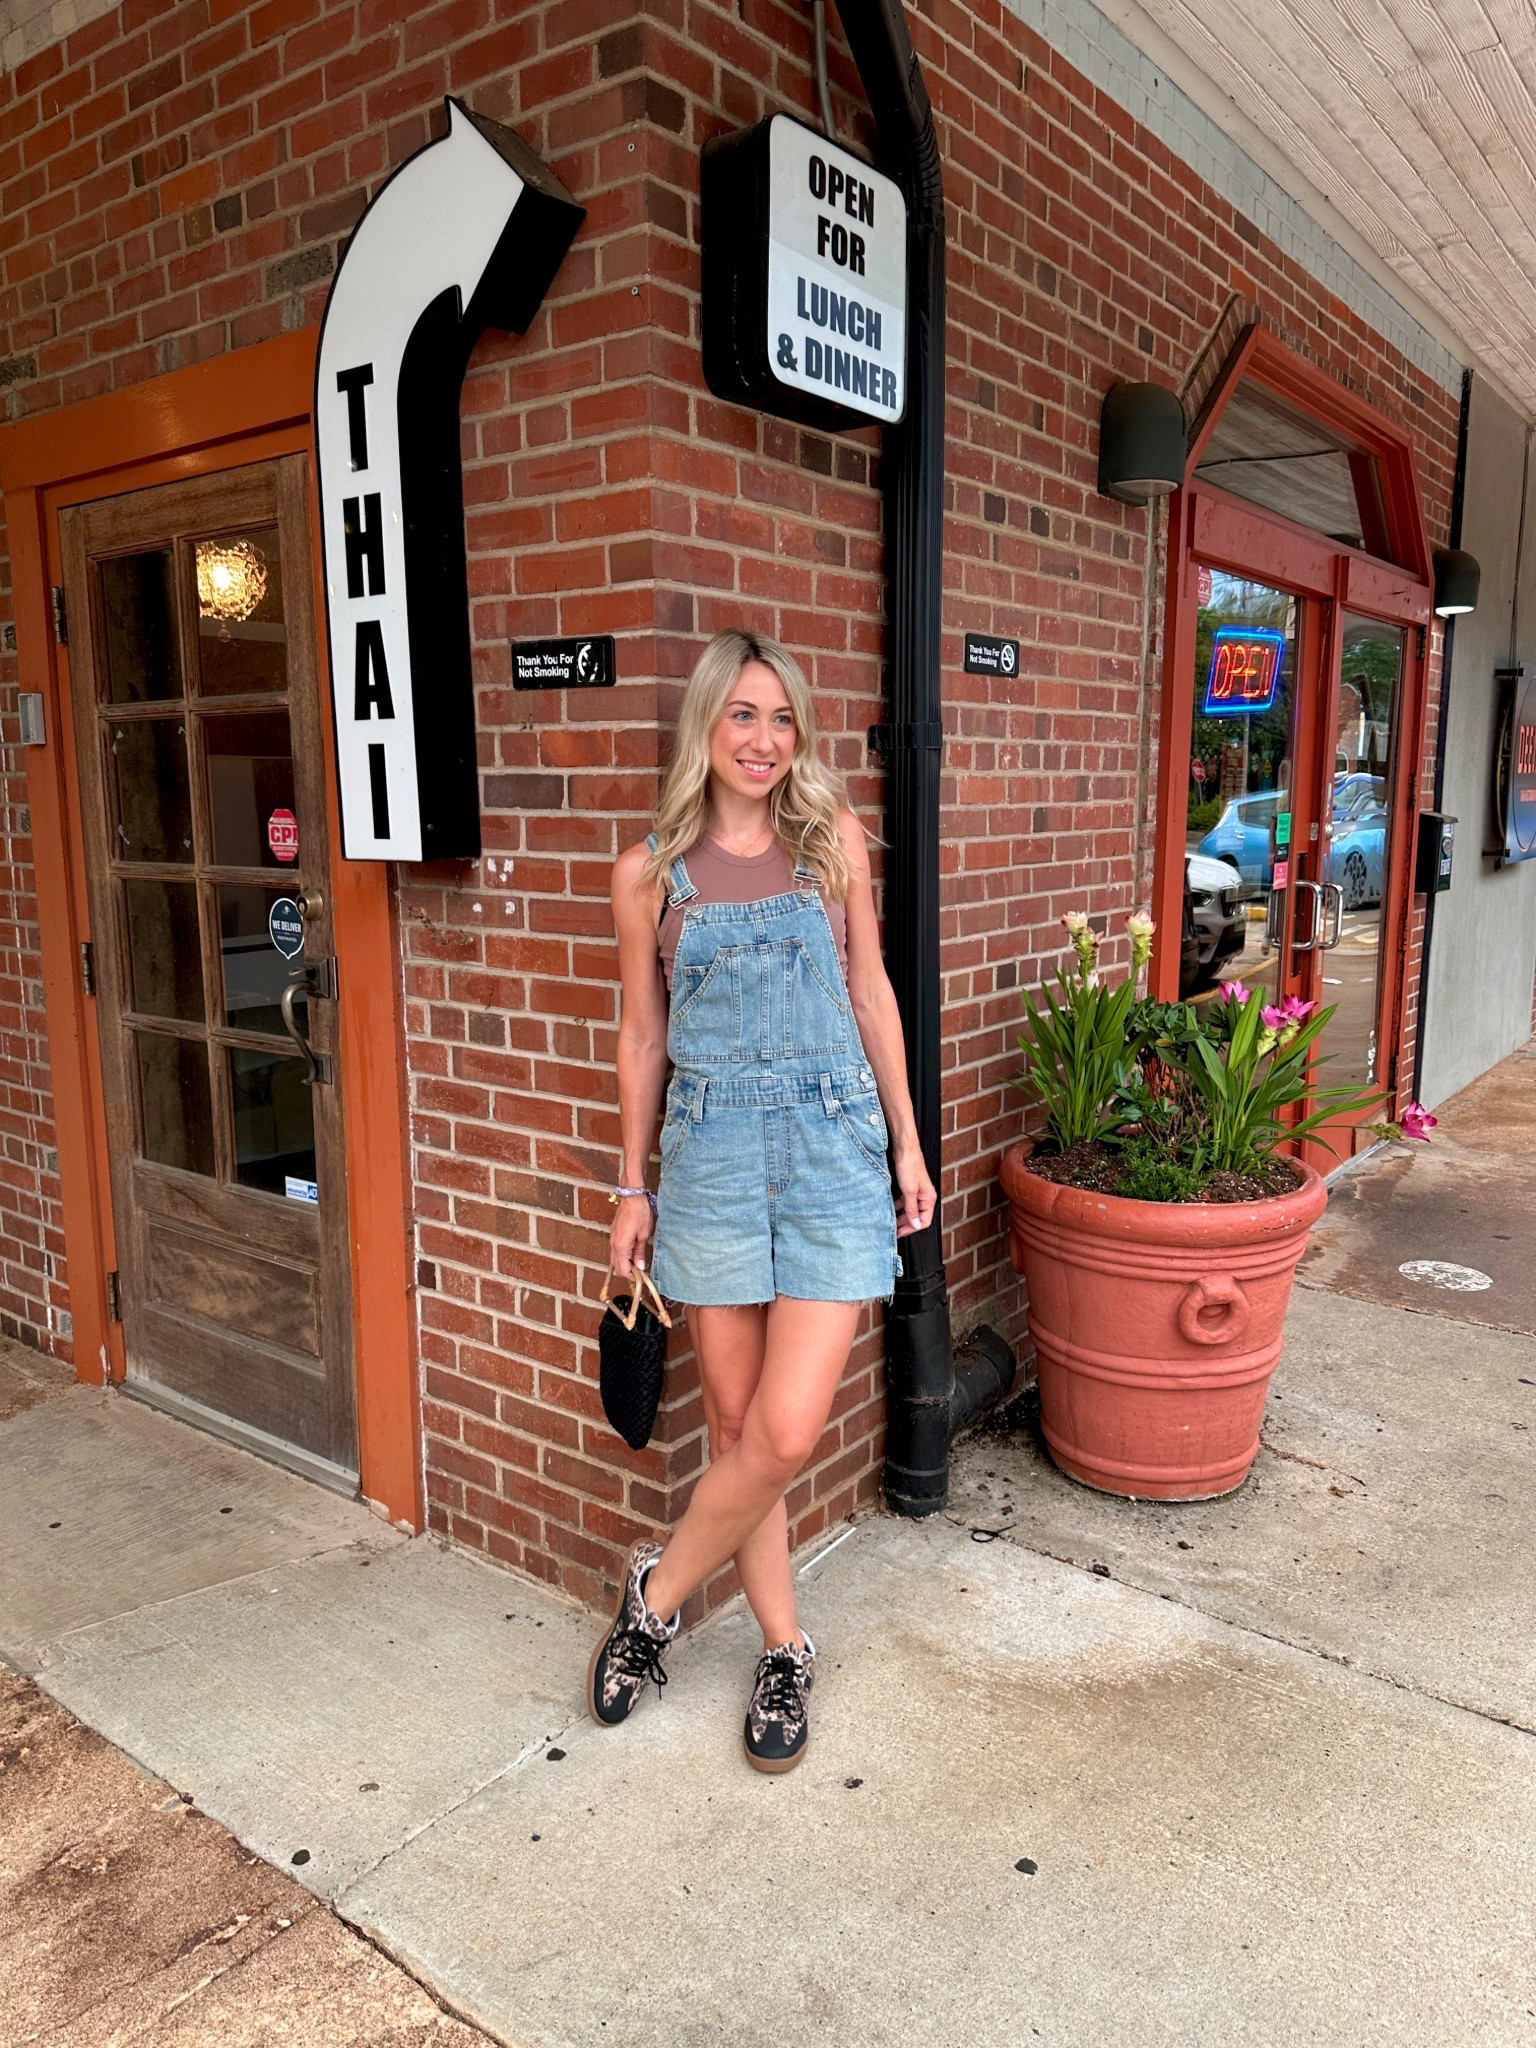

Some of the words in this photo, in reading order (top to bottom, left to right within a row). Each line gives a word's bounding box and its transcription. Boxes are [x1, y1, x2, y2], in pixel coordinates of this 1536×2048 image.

[808, 155, 875, 229] OPEN
[817, 214, 866, 277] FOR
[797, 276, 882, 351] LUNCH
[777, 333, 798, 373] &
[805, 336, 897, 410] DINNER
[336, 362, 396, 840] THAI
[516, 655, 541, 666] Thank
[542, 654, 558, 665] You
[559, 653, 574, 664] For
[518, 667, 533, 678] Not
[533, 666, 569, 678] Smoking
[969, 644, 983, 655] Thank
[983, 646, 992, 656] You
[992, 648, 1000, 657] For
[970, 654, 978, 663] Not
[978, 655, 997, 668] Smoking
[1212, 644, 1277, 698] OPEN
[1517, 726, 1536, 774] DEE
[272, 919, 281, 930] WE
[281, 920, 302, 933] DELIVER
